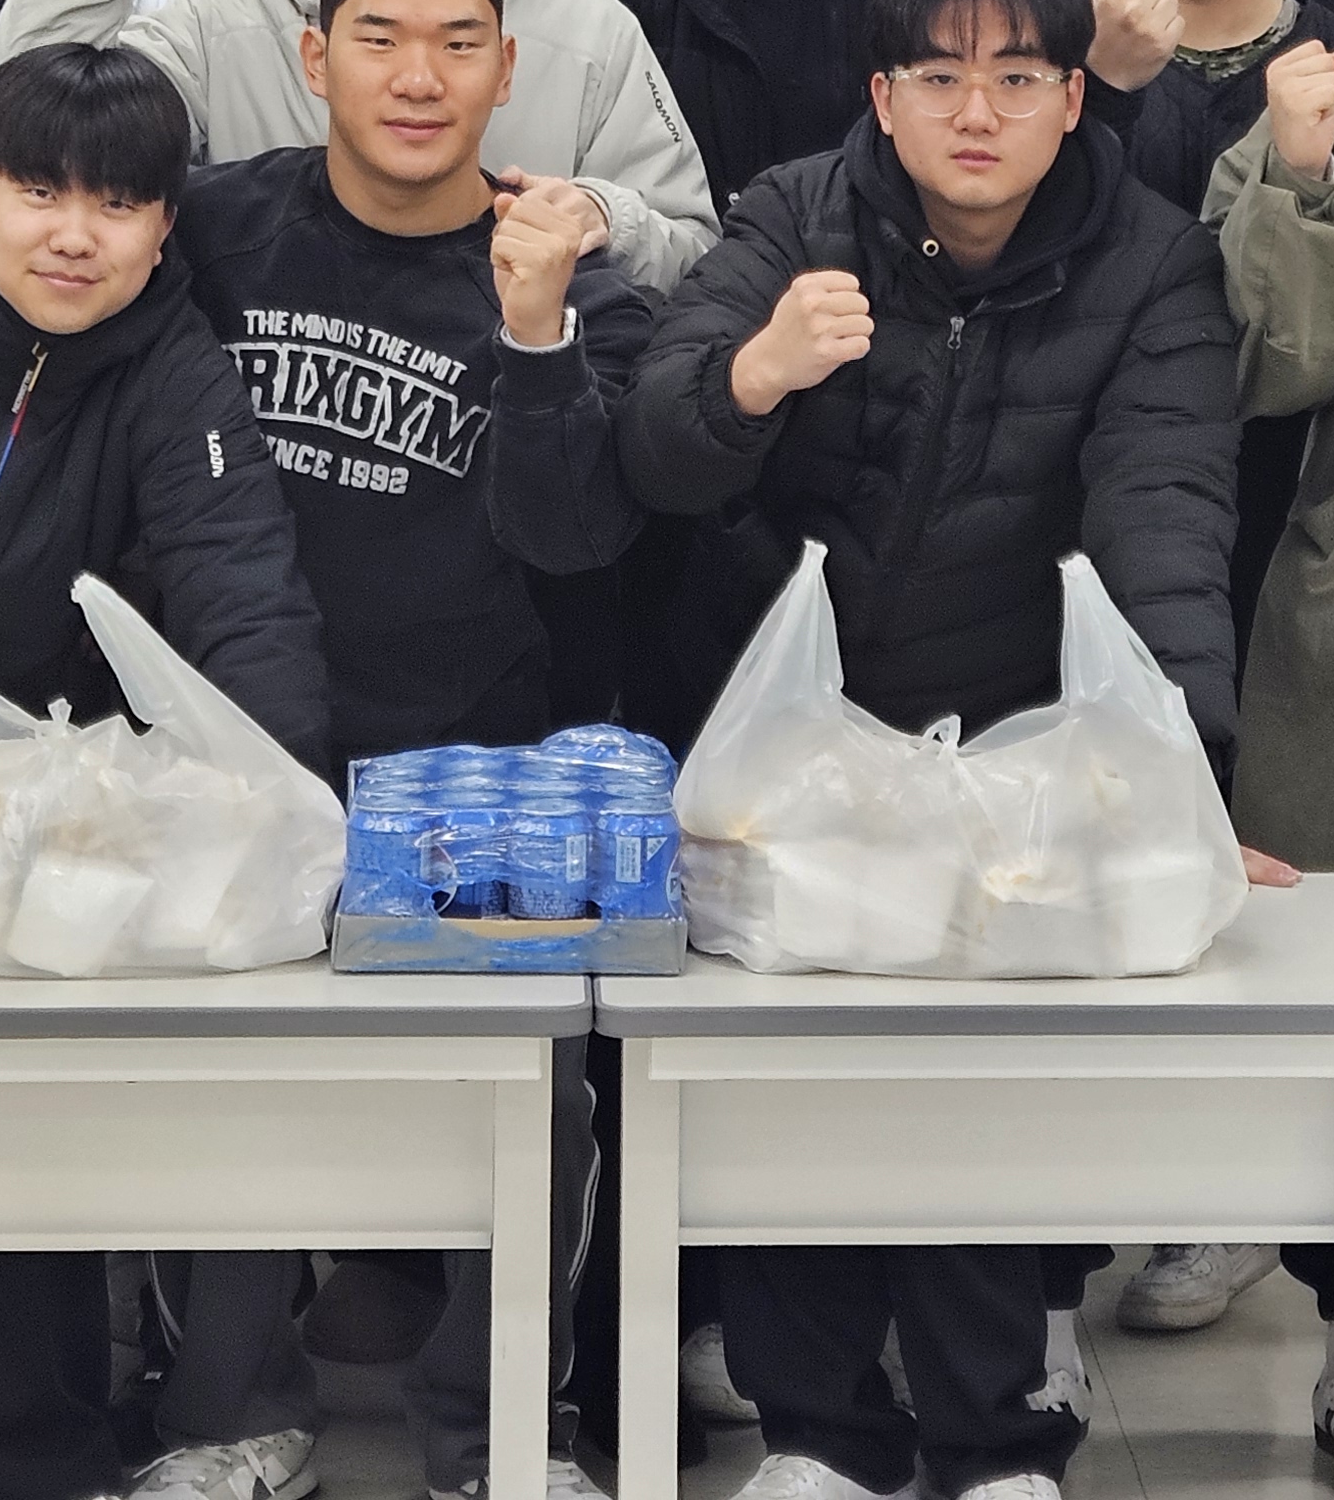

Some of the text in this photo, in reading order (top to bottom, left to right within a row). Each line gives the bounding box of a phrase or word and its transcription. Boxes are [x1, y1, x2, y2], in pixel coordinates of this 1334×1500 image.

[645, 70, 682, 143] SALOMON
[243, 310, 468, 386] THE MIND IS THE LIMIT
[222, 342, 492, 479] RIXGYM
[261, 432, 410, 495] NCE 1992
